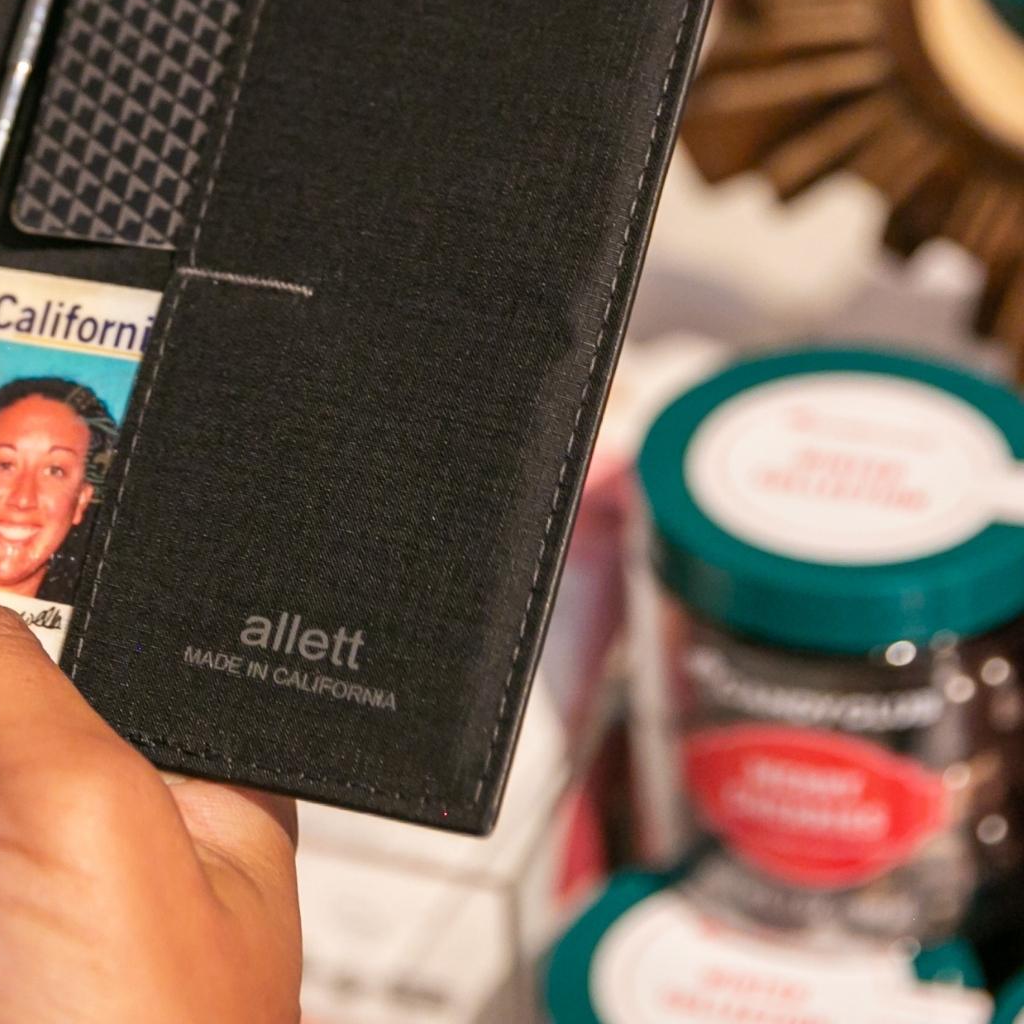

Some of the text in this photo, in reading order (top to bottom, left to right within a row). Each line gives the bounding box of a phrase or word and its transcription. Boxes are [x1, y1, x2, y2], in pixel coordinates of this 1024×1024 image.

[239, 611, 365, 671] allett
[183, 645, 397, 712] MADE IN CALIFORNIA
